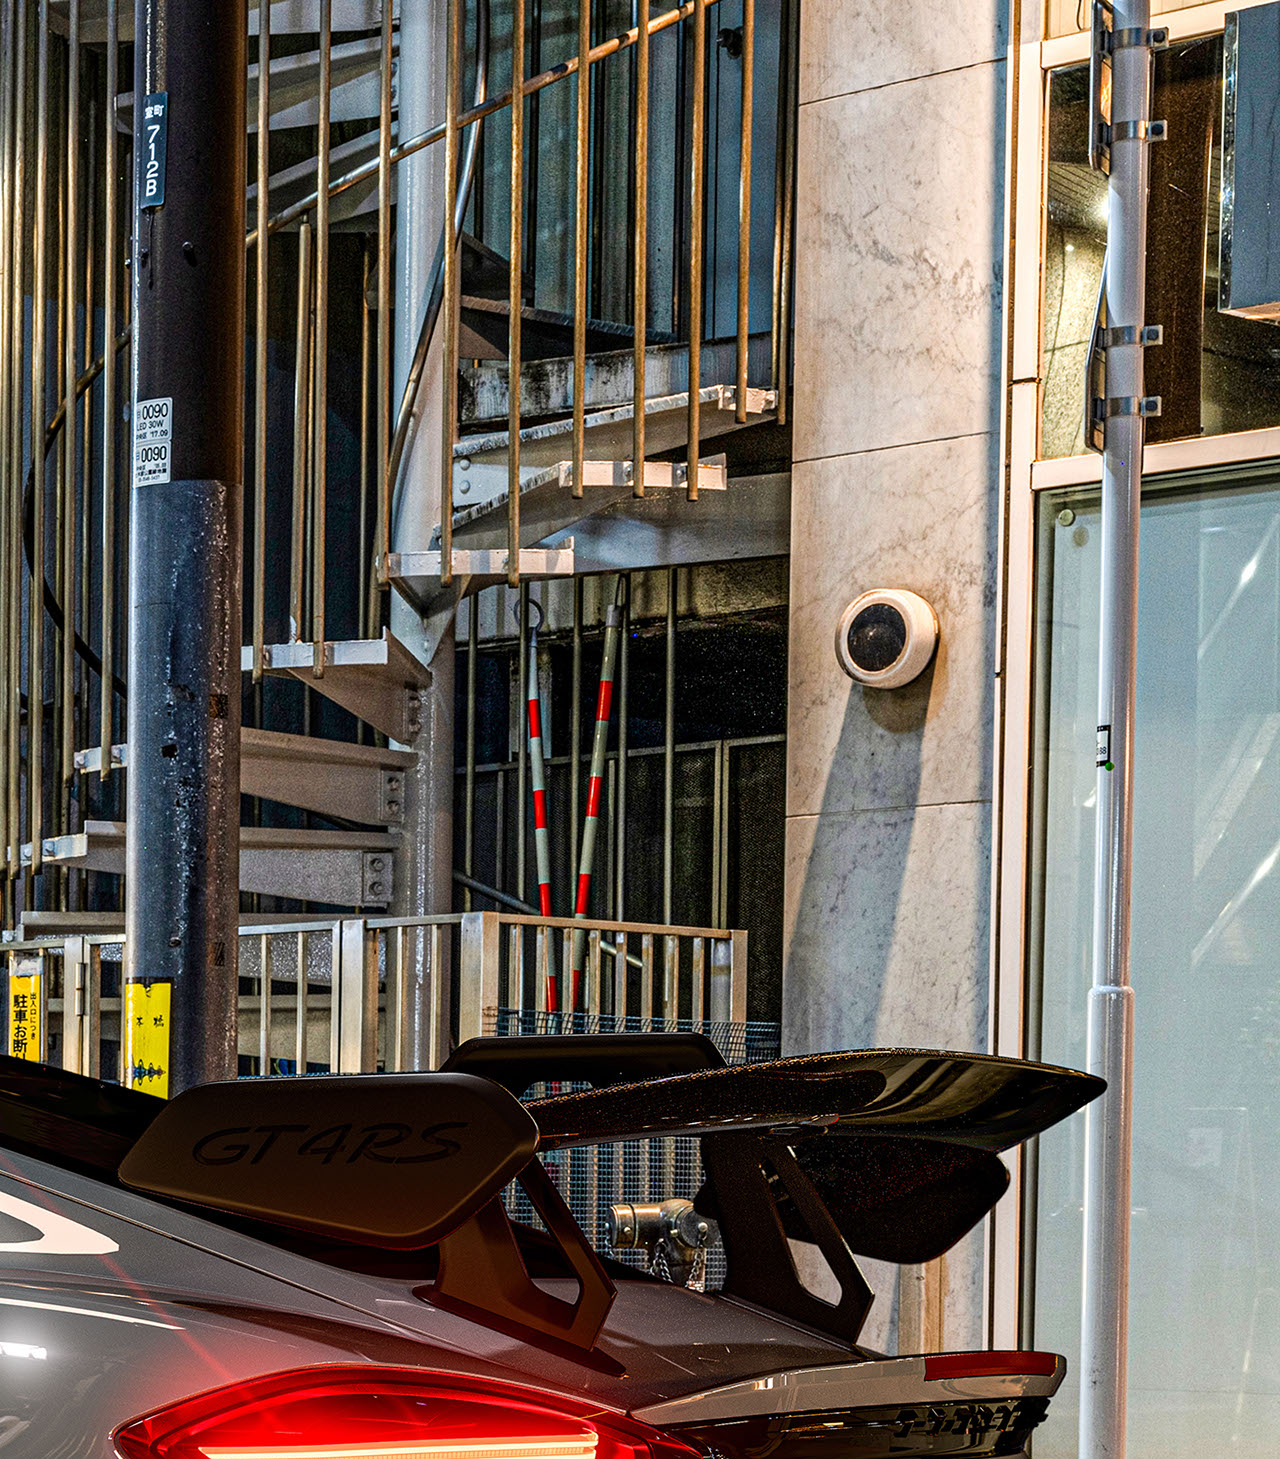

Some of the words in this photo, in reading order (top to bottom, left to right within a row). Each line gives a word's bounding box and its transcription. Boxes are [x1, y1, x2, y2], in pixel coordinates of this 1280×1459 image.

[145, 105, 164, 119] 室町
[146, 124, 160, 197] 712B
[142, 402, 168, 420] 0090
[141, 445, 167, 463] 0090
